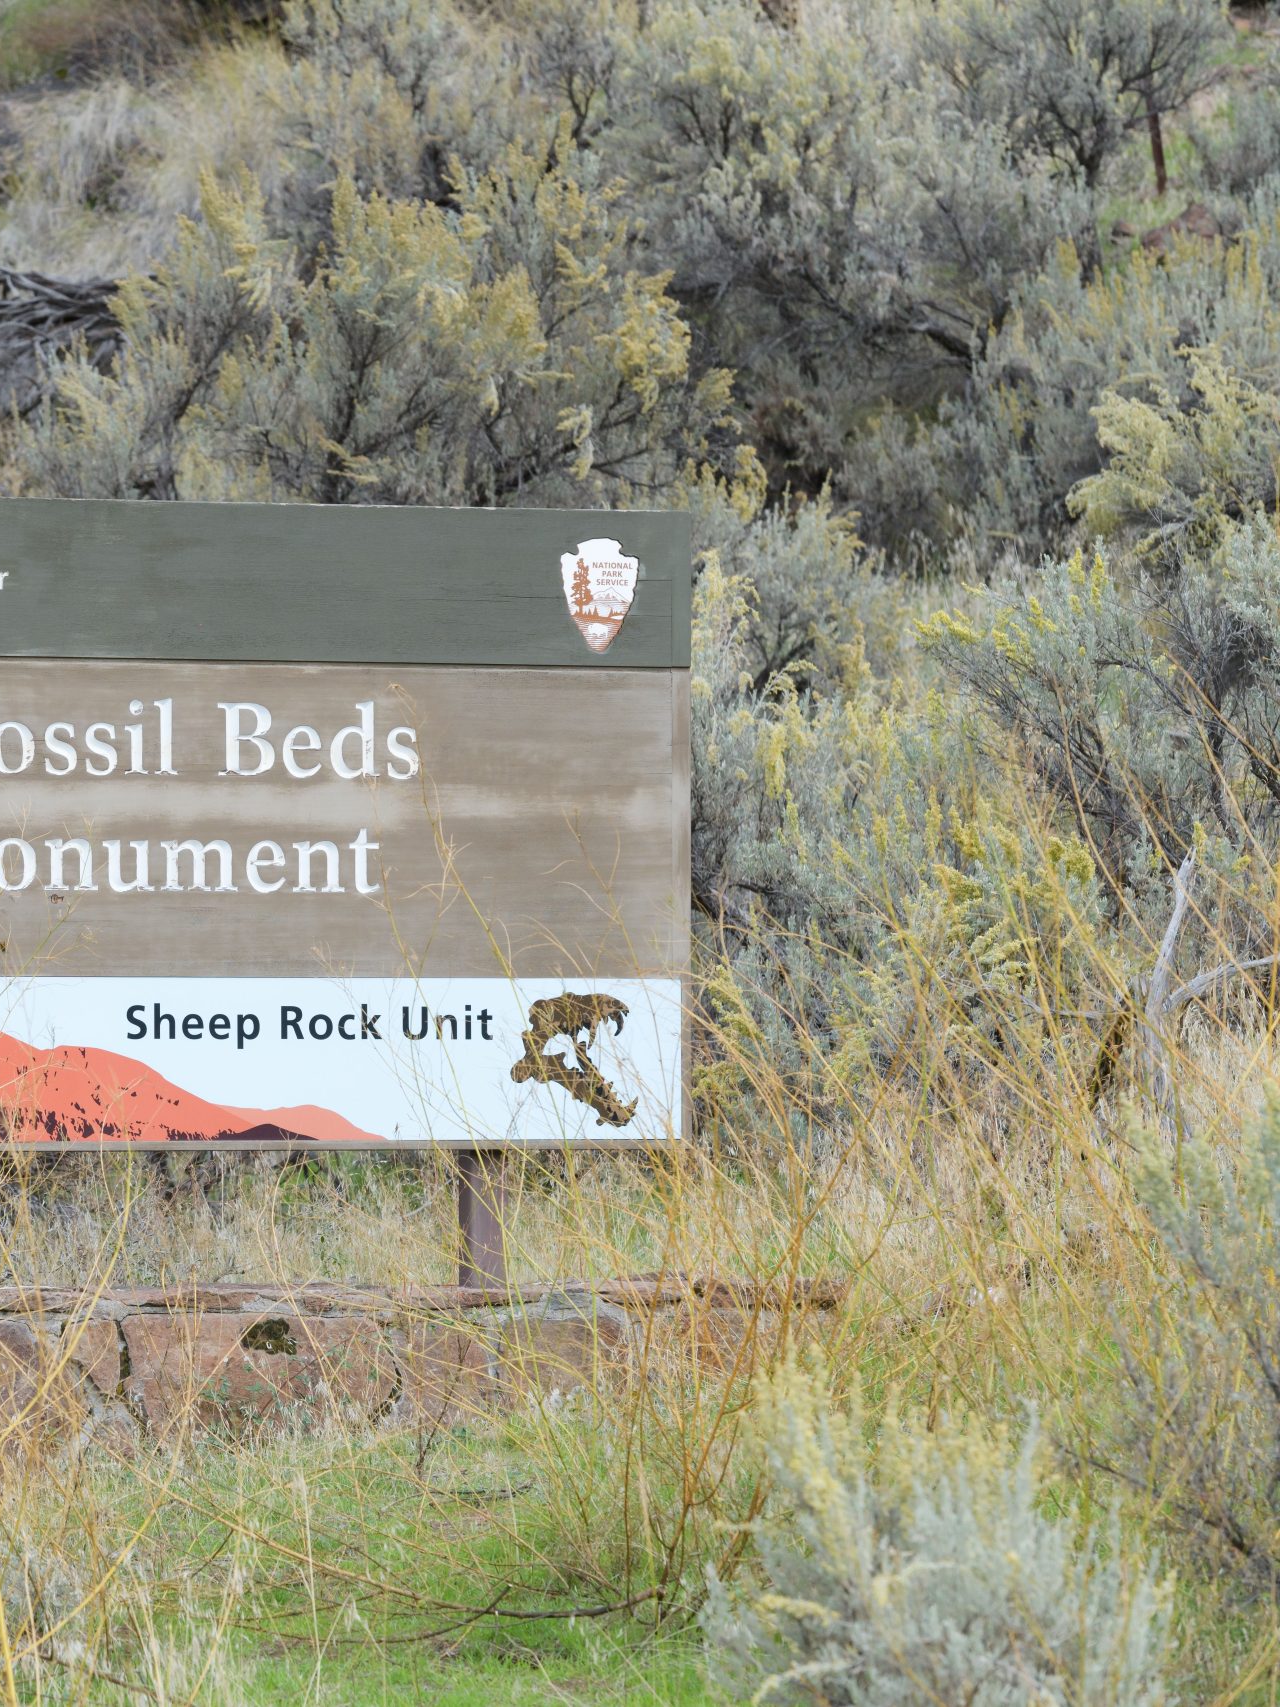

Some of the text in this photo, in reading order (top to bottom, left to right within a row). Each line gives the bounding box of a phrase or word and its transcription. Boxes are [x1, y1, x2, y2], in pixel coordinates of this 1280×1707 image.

[592, 562, 633, 570] NATIONAL
[602, 570, 623, 578] PARK
[596, 578, 629, 586] SERVICE
[217, 700, 420, 780] Beds
[125, 1003, 494, 1050] Sheep Rock Unit
